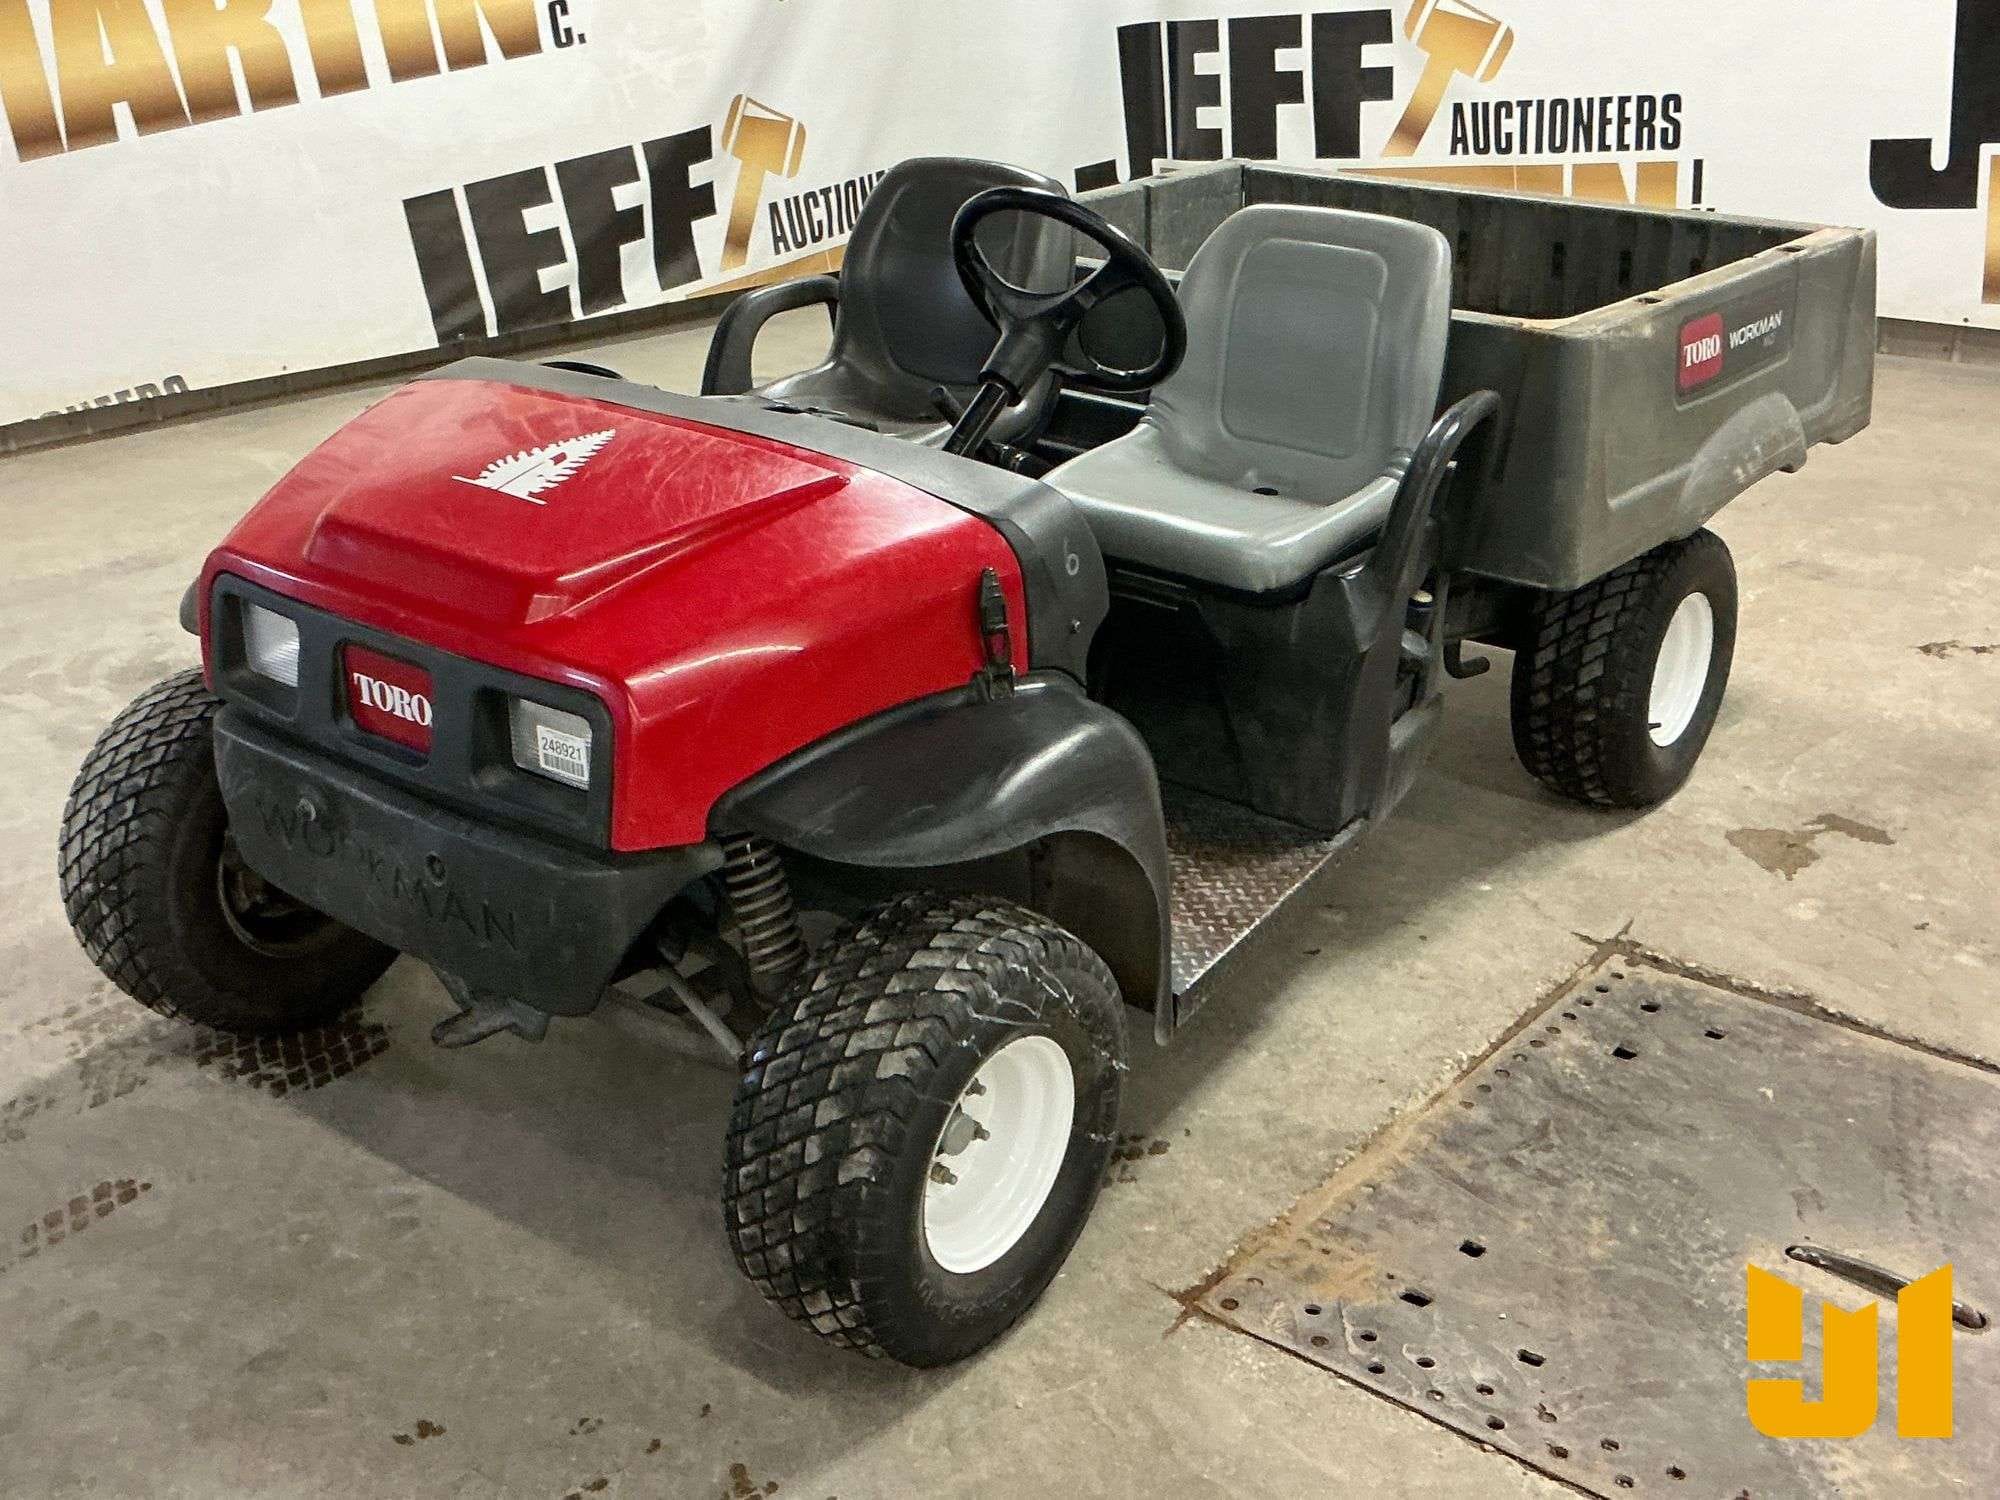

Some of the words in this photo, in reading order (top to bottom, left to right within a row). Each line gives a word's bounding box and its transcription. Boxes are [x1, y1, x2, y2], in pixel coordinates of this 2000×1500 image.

[1074, 9, 1394, 193] JEFF
[1450, 94, 1682, 155] AUCTIONEERS
[1683, 334, 1720, 368] TORO
[1729, 309, 1783, 350] WORKMAN
[353, 672, 433, 726] TORO
[541, 737, 582, 761] 248921
[254, 795, 521, 952] WOKMAN
